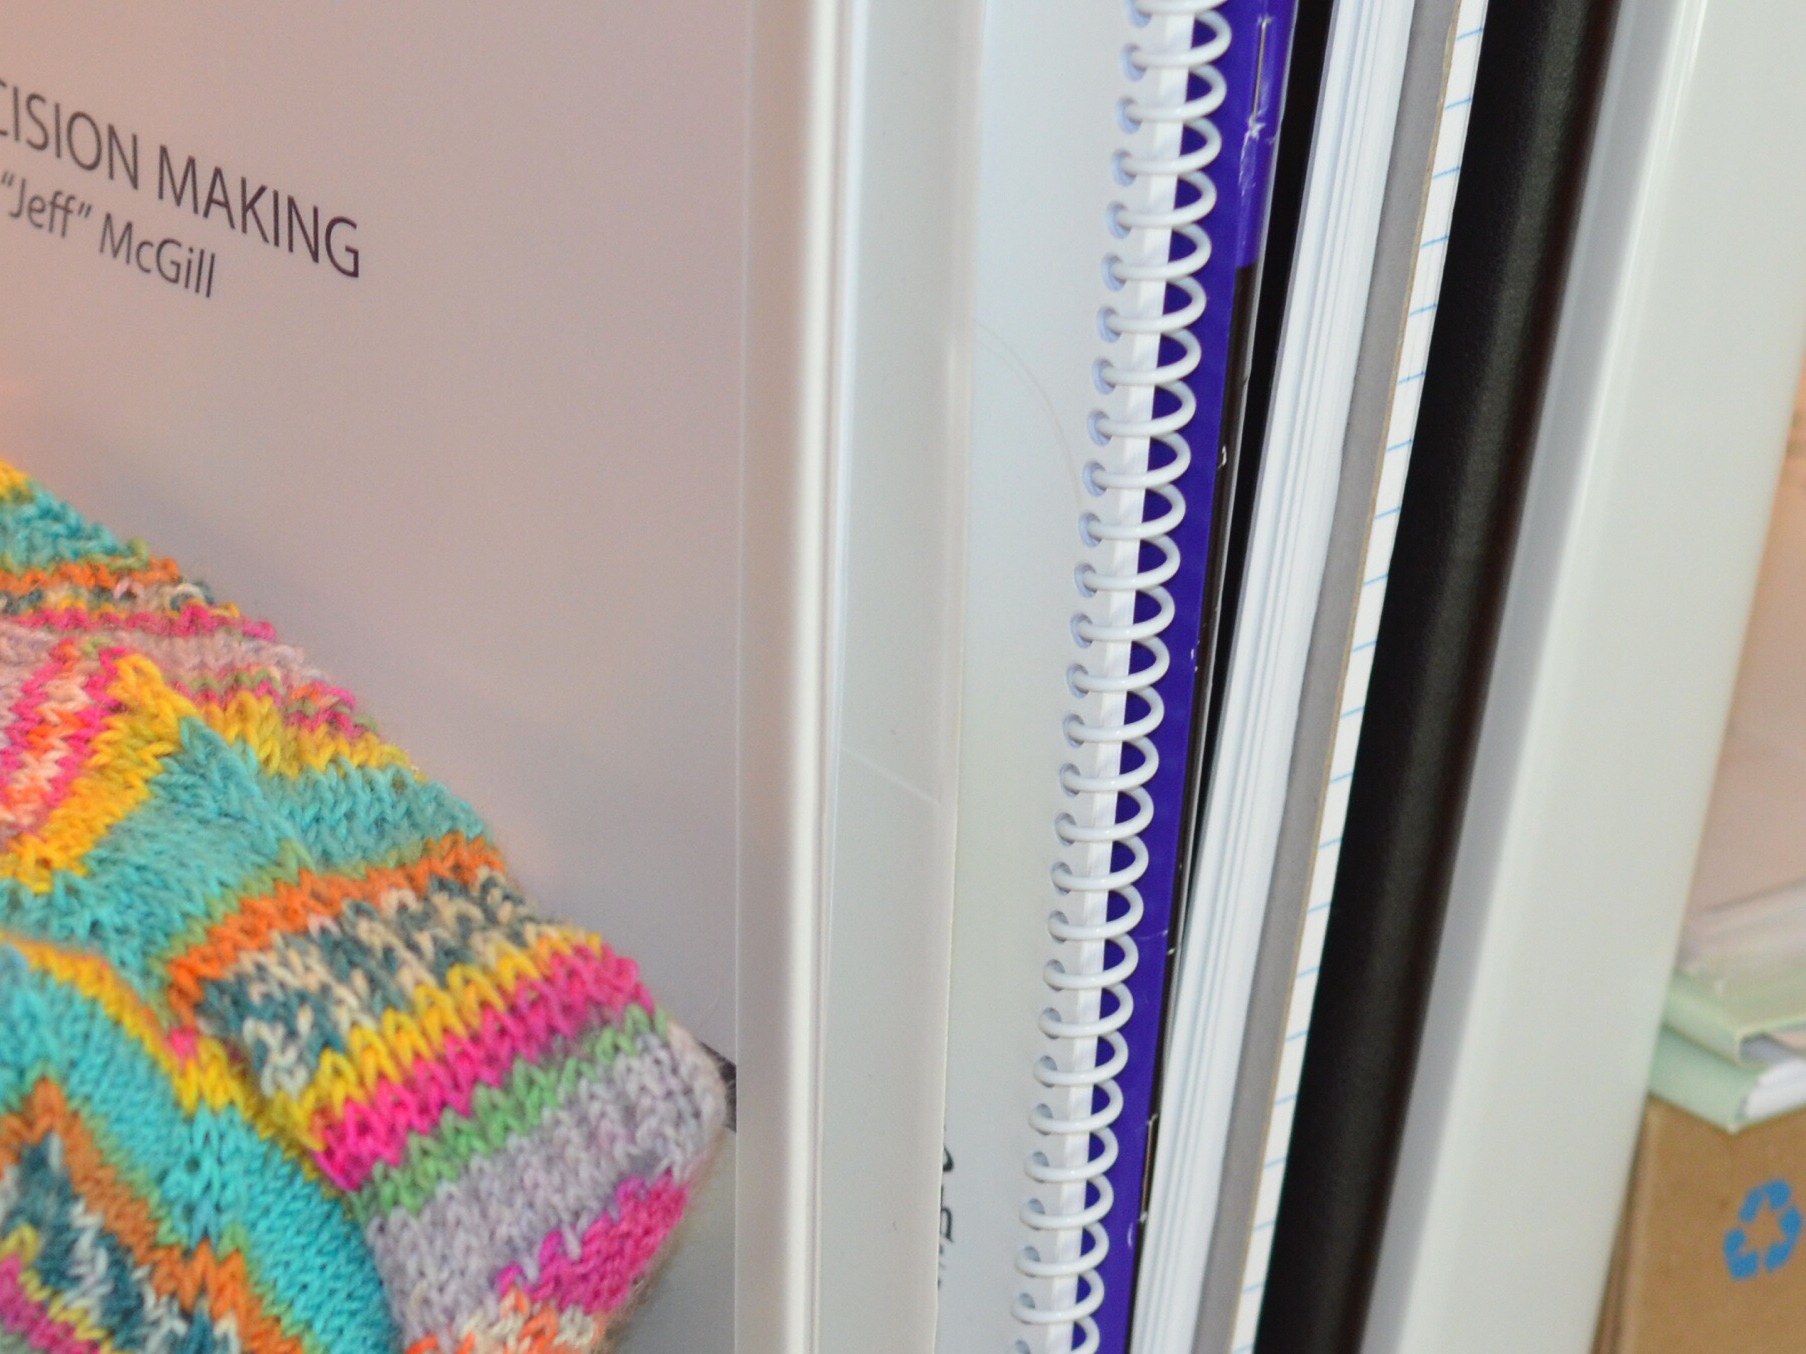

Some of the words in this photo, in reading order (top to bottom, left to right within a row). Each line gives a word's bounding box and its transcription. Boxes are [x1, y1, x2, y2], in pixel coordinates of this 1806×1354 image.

[0, 169, 93, 239] "Jeff"
[98, 212, 217, 299] McGill
[156, 144, 361, 280] MAKING
